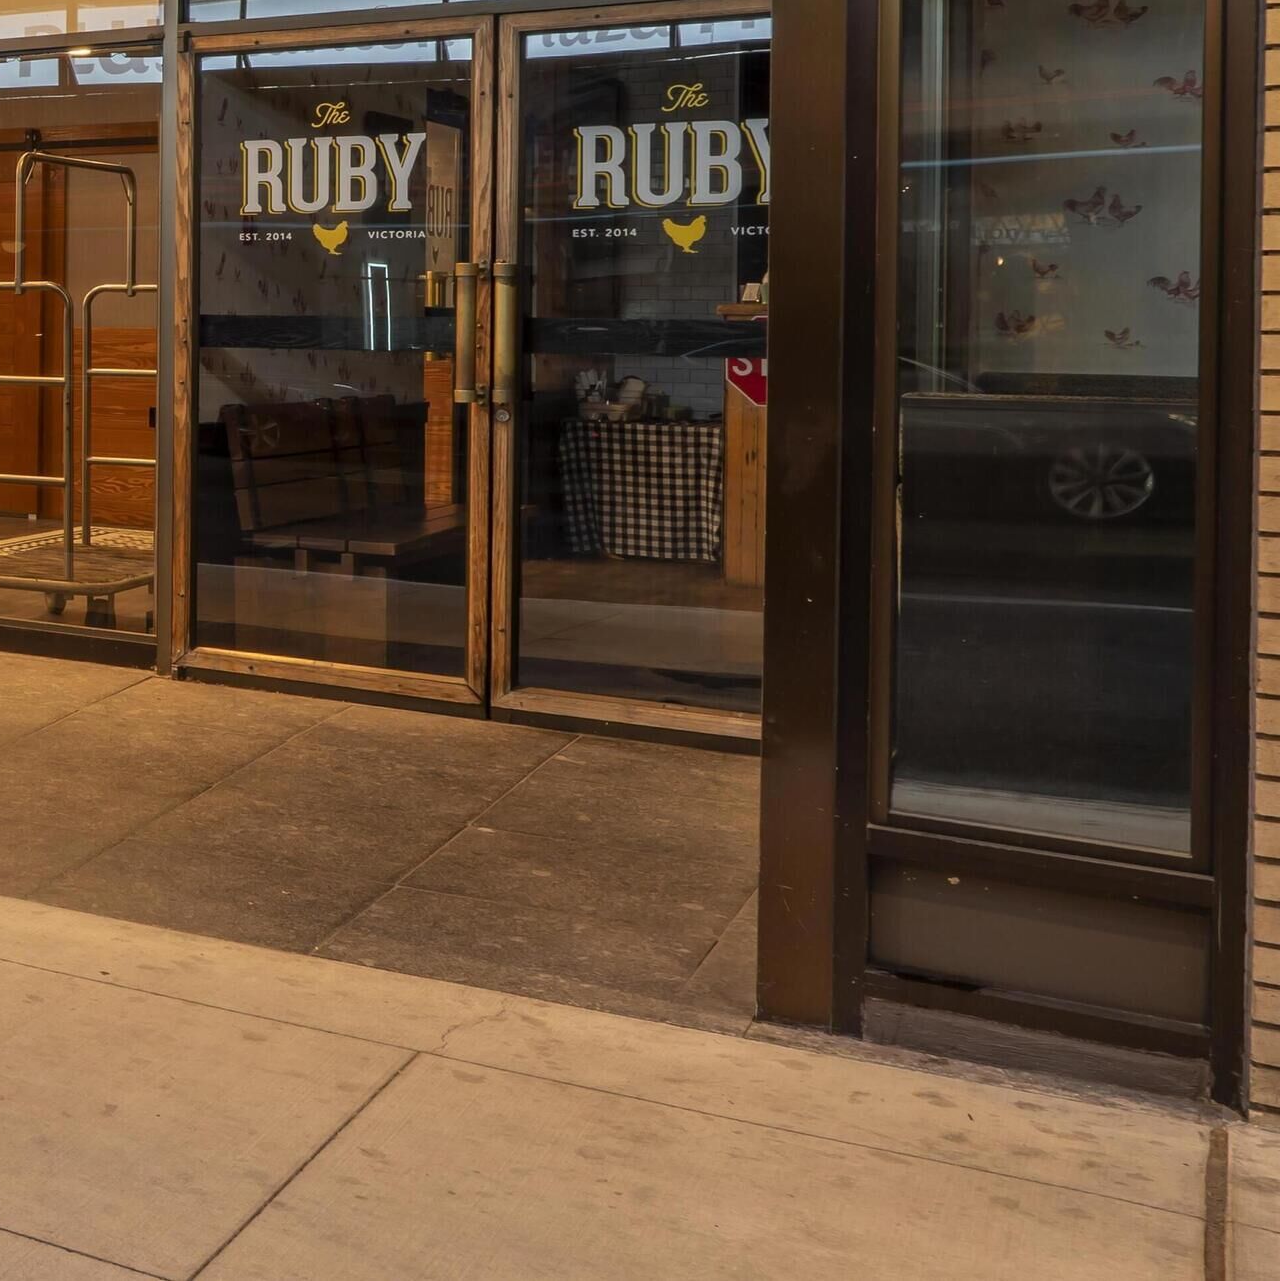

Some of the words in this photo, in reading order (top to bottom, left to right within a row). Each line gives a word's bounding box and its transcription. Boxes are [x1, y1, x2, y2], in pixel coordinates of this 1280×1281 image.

[661, 83, 709, 112] The
[311, 101, 350, 128] The
[240, 132, 427, 216] RUBY
[239, 232, 261, 241] EST.
[266, 232, 293, 241] 2014
[367, 230, 426, 240] VICTORIA
[572, 228, 599, 238] EST.
[605, 228, 637, 237] 2014
[730, 226, 770, 236] VICT
